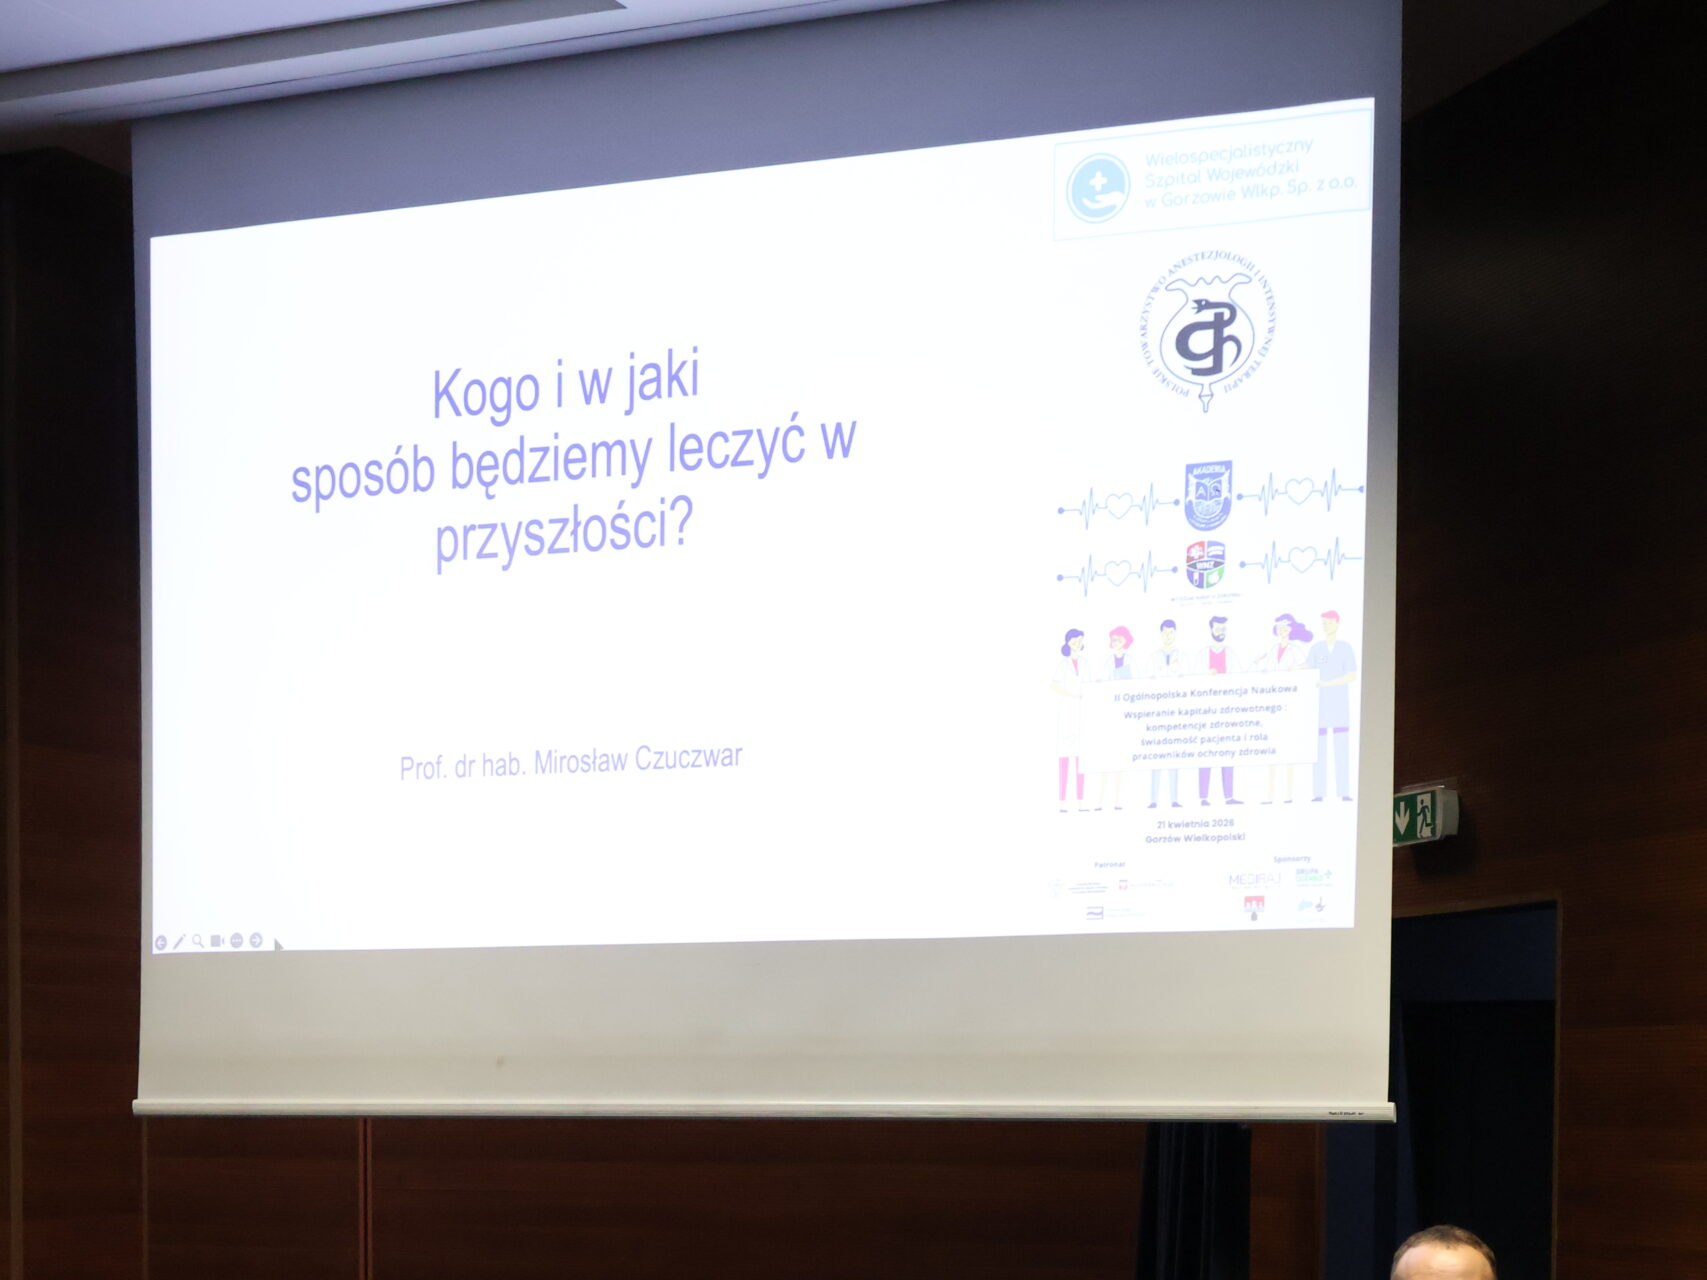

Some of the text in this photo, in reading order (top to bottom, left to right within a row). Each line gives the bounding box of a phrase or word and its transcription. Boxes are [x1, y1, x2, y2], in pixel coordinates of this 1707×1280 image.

[1145, 138, 1314, 168] Wielospecjalistyczny
[1145, 159, 1300, 189] Szpital Wojewódzki
[1144, 197, 1157, 208] w
[1161, 187, 1236, 208] Gorzowie
[1287, 178, 1312, 197] Sp.
[1316, 178, 1325, 191] z
[1328, 175, 1359, 190] o.o.
[434, 346, 699, 427] Kogo i w jaki
[292, 411, 857, 514] sposób będziemy leczyć w
[436, 495, 694, 575] przyszłości?
[1113, 684, 1298, 703] II Ogólnopolska Konferencja Naukowa
[1124, 708, 1176, 720] Wspieranie
[1178, 705, 1217, 718] kapitału
[1219, 702, 1282, 715] zdrowotnego
[1146, 718, 1263, 734] kompetencje zdrowotne,
[1140, 735, 1198, 747] świadomość
[1200, 733, 1241, 746] pacjenta
[1250, 732, 1268, 742] rola
[401, 745, 743, 781] Prof. dr hab. Mirosław Czuczwar
[1132, 746, 1277, 763] pracowników ochrony zdrowia
[1167, 819, 1210, 829] kwietnia
[1145, 831, 1246, 844] Gorzów Wielkopolski
